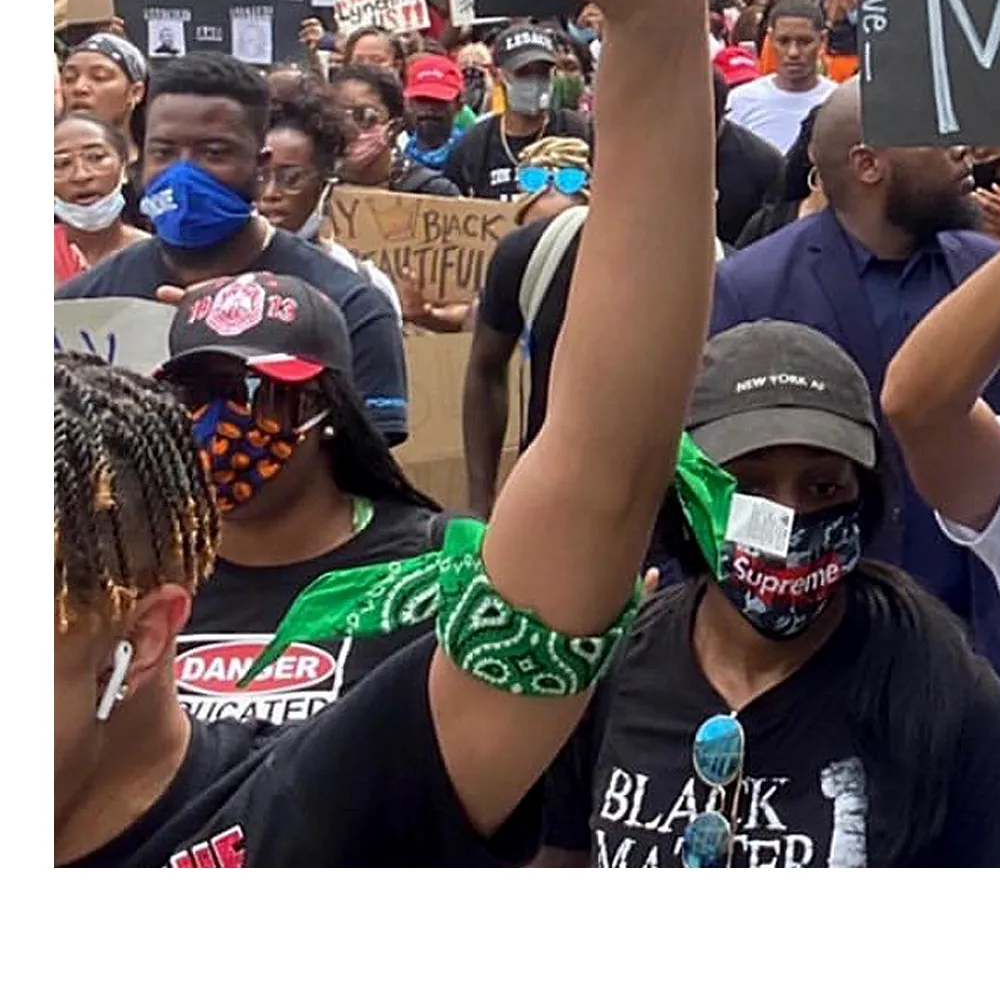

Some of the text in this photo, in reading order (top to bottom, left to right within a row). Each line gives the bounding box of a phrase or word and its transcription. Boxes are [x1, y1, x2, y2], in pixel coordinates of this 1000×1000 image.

[423, 211, 506, 245] BLACK
[736, 376, 767, 393] NEW
[769, 373, 808, 388] YORK
[733, 555, 840, 597] Supreme
